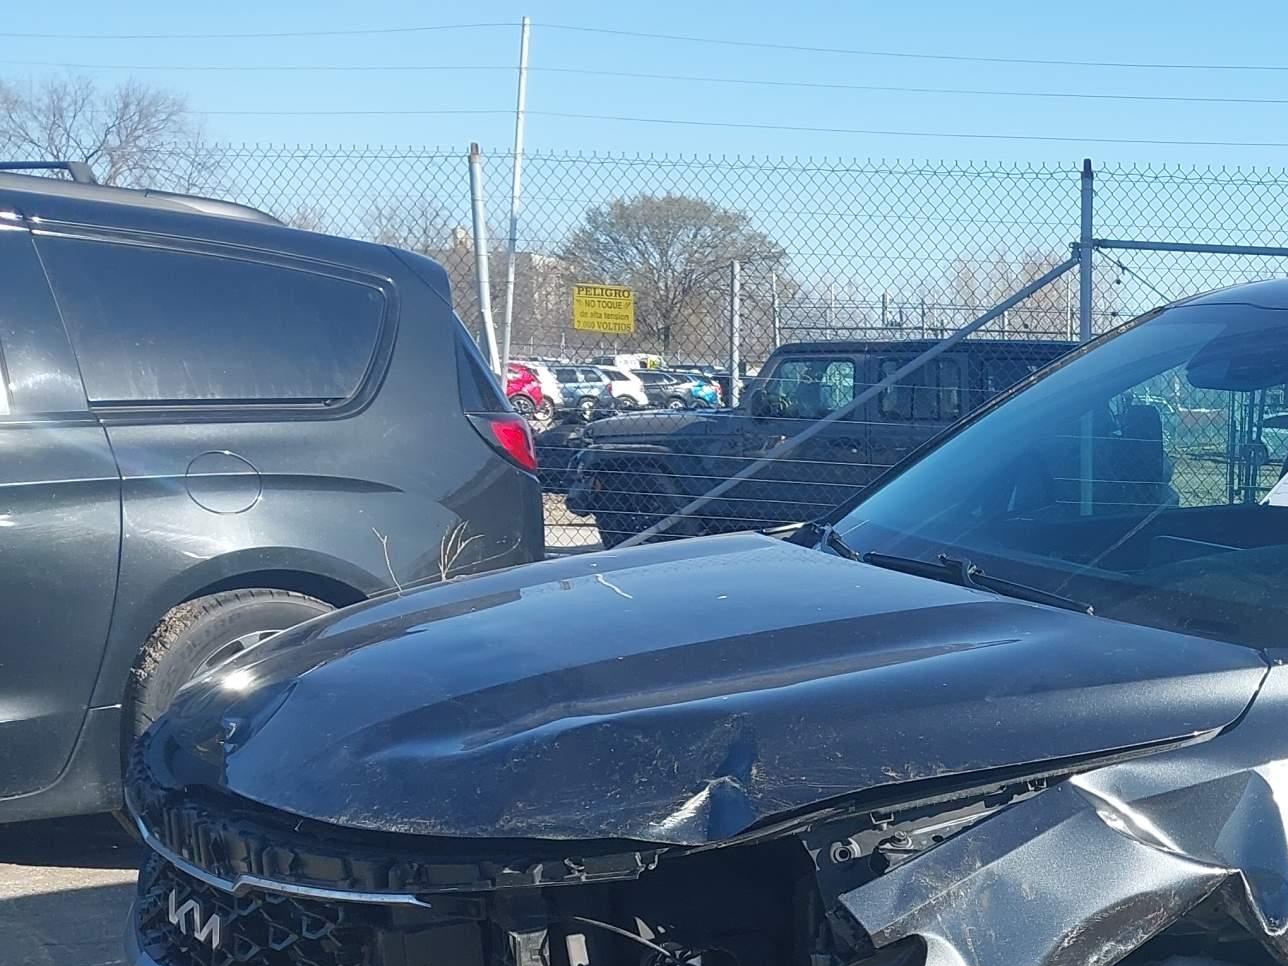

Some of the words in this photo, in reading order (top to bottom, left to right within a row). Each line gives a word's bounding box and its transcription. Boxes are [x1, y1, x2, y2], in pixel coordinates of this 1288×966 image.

[577, 287, 630, 298] PELIGRO
[584, 299, 595, 308] NO
[597, 300, 622, 309] TOQUE
[596, 321, 632, 331] VOLTIOS
